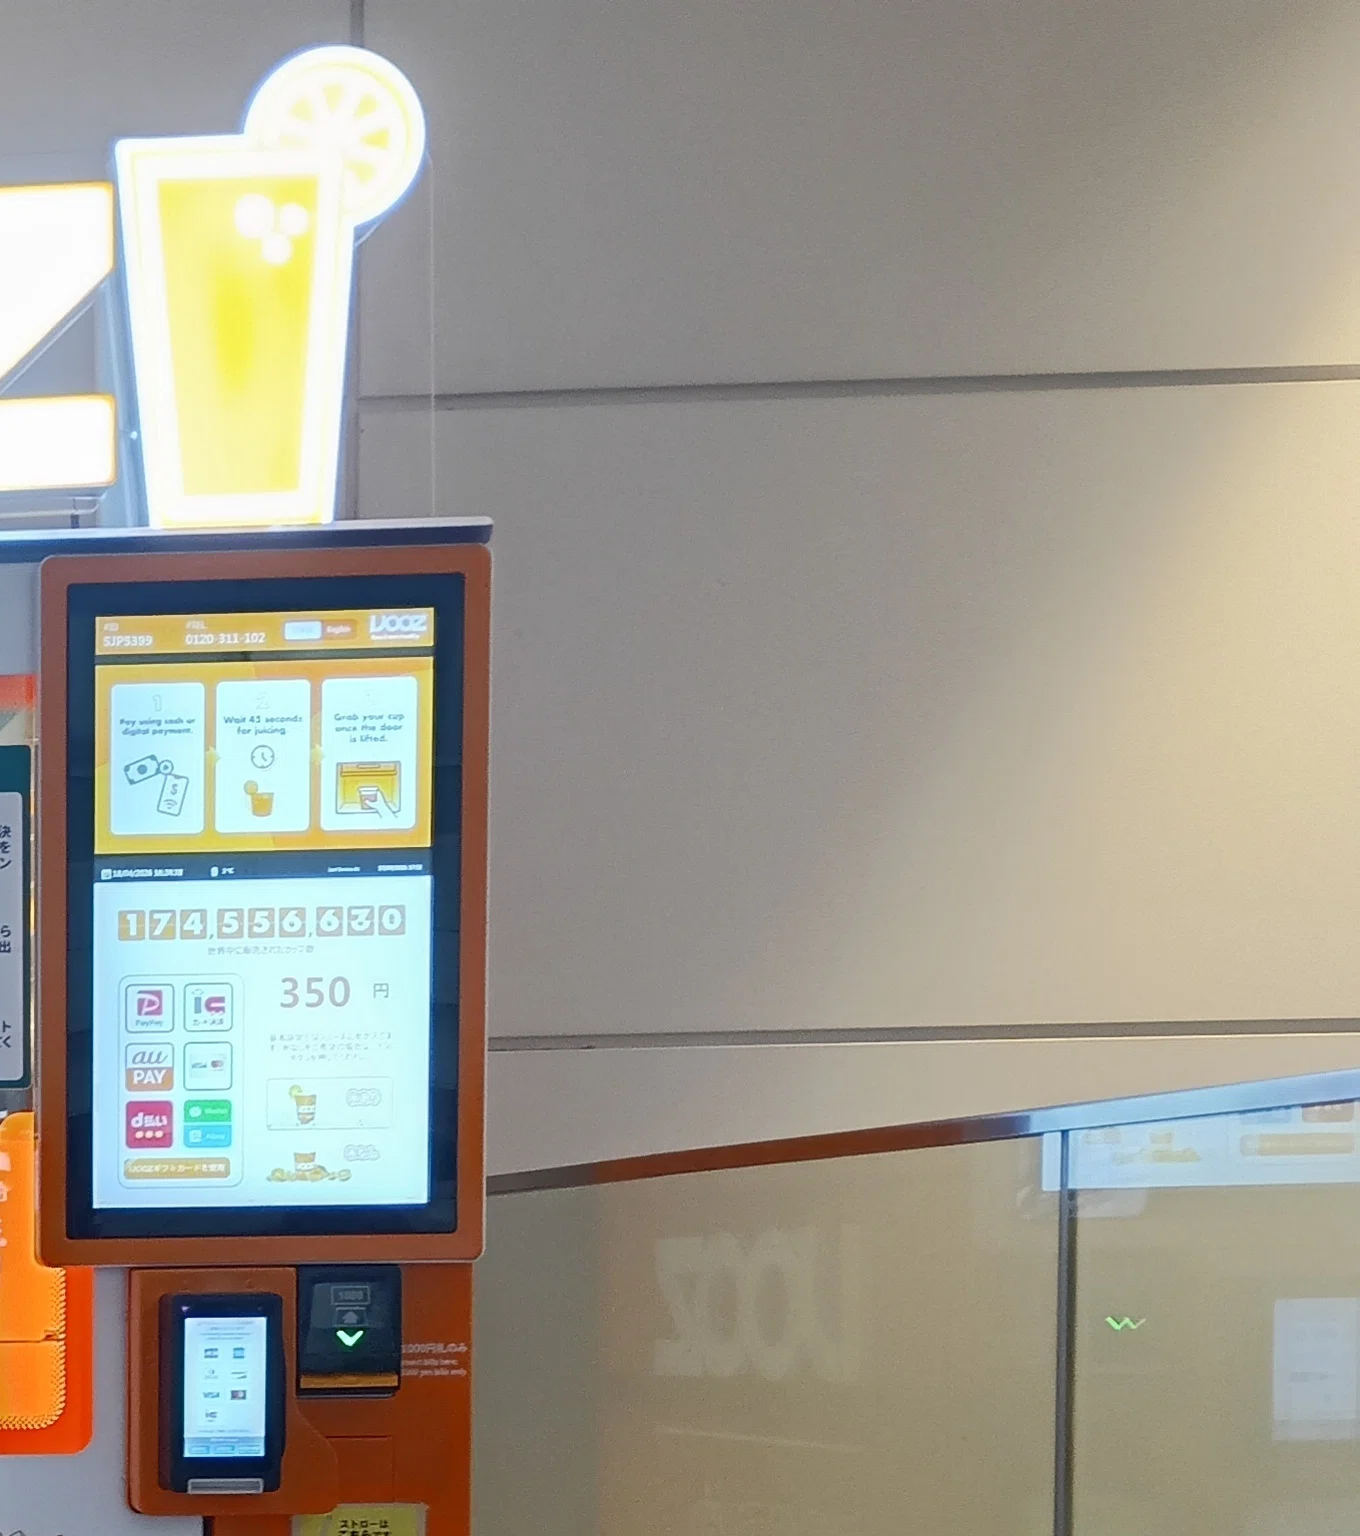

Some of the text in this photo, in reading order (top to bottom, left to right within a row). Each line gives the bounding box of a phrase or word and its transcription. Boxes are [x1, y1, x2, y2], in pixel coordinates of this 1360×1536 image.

[185, 632, 266, 645] 0120-311-102
[279, 976, 390, 1008] 350 円
[132, 1047, 169, 1065] au
[132, 1069, 167, 1085] PAY
[340, 1519, 389, 1529] ストローは
